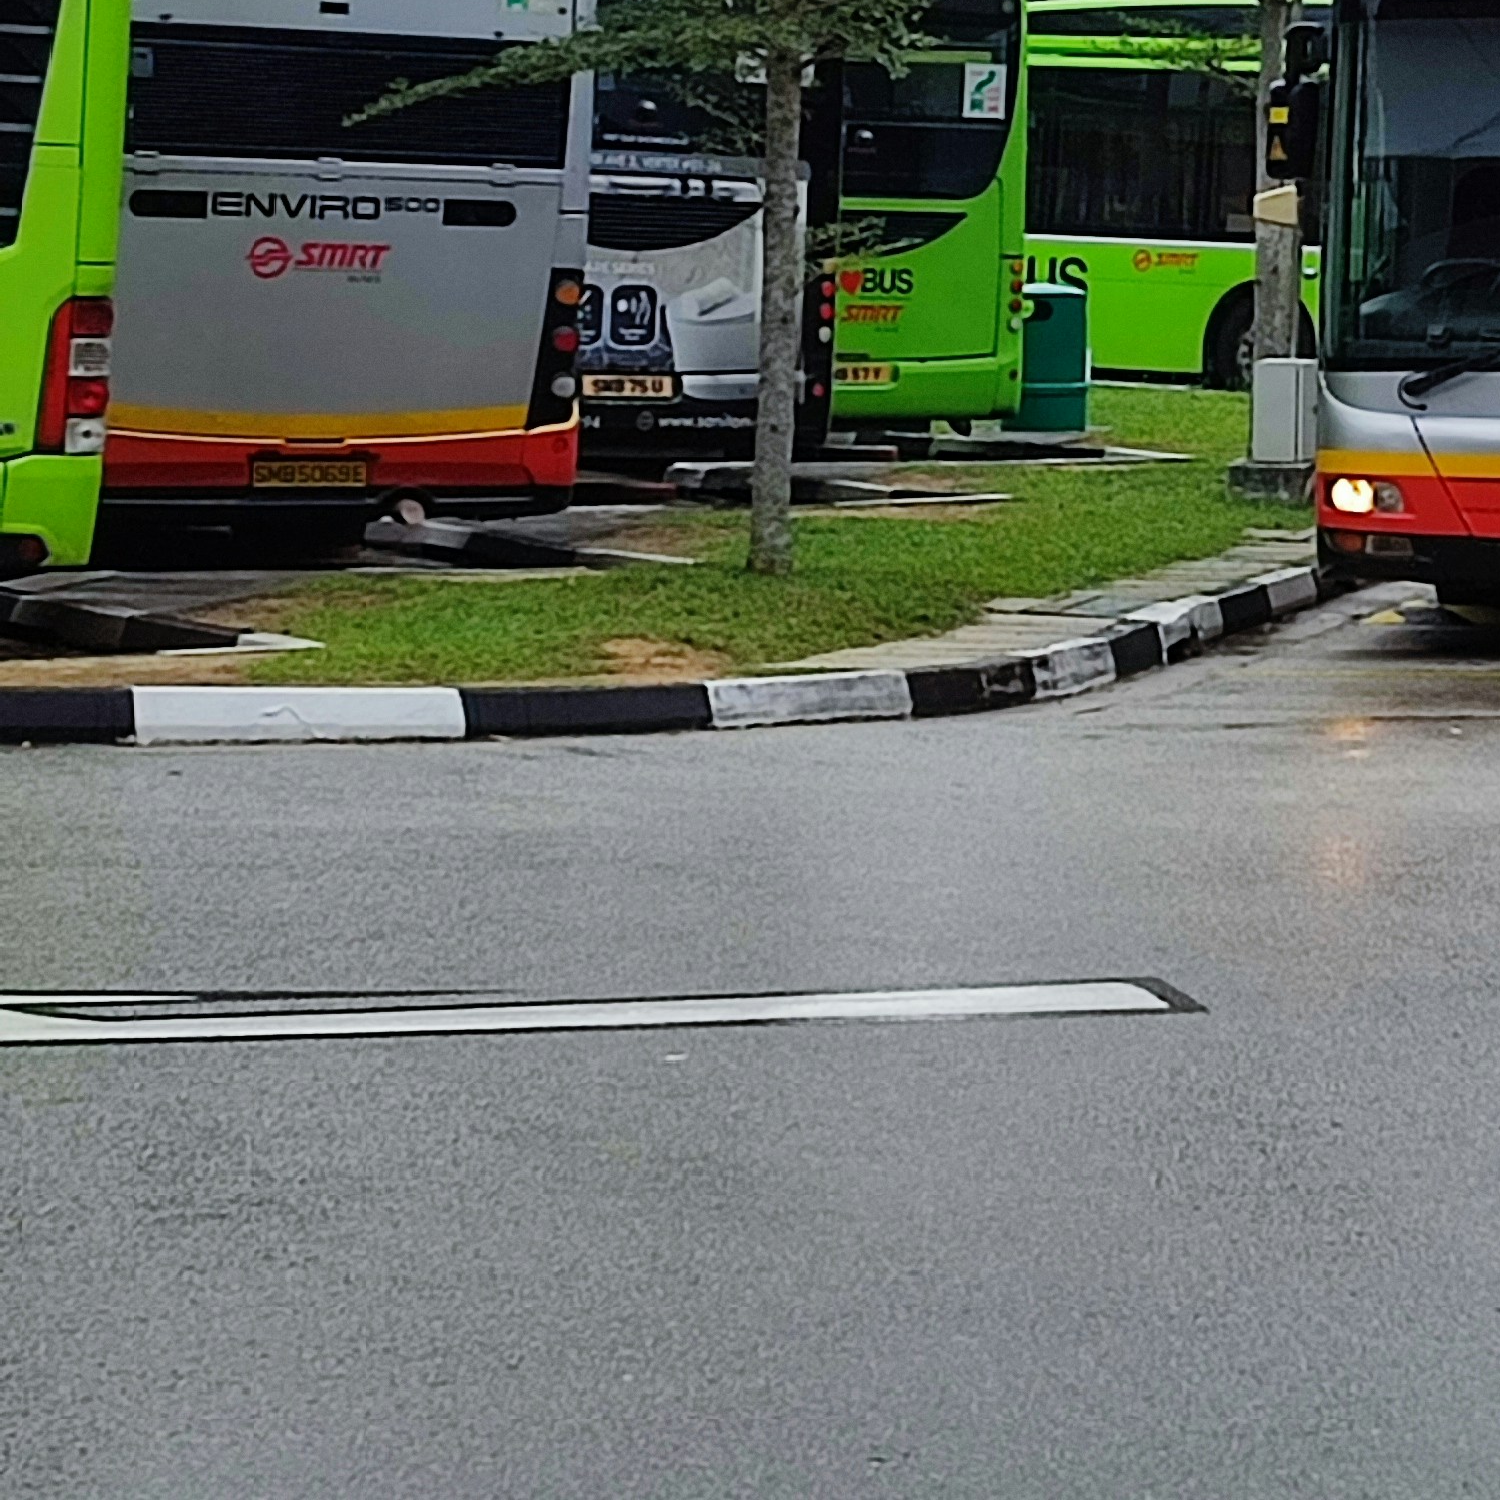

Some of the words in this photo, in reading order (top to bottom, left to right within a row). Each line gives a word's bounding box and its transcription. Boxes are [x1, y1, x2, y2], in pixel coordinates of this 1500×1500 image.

[295, 242, 392, 269] SMRT
[860, 267, 914, 295] BUS
[841, 304, 903, 323] SMRT
